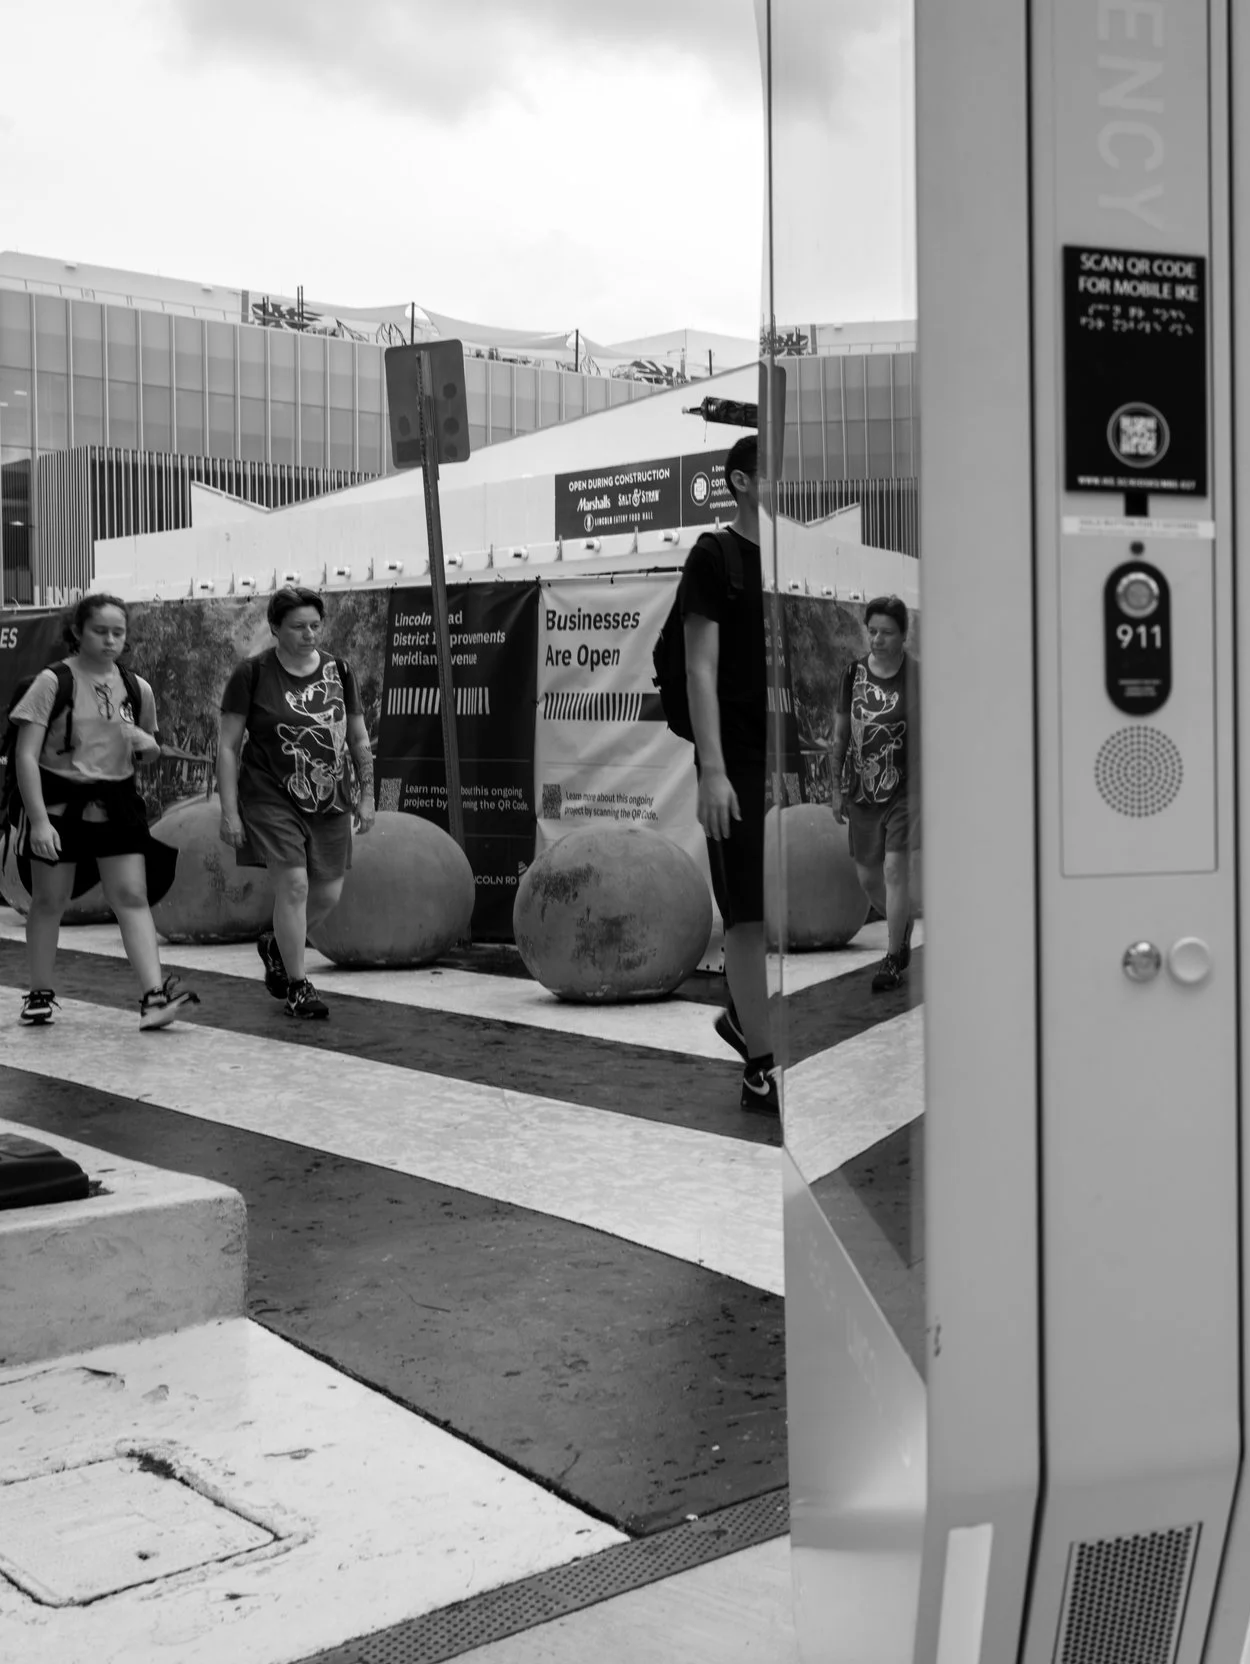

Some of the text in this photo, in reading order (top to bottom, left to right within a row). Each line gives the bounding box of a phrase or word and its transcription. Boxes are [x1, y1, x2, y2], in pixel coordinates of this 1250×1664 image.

[1080, 252, 1197, 279] SCAN QR CODE
[1078, 275, 1111, 295] FOR
[1113, 278, 1172, 300] MOBILE
[568, 468, 670, 492] OPEN DURING CONSTRUCTION
[577, 494, 611, 512] Marshalls
[395, 611, 432, 627] Lincoln
[546, 607, 641, 631] Businesses
[393, 629, 506, 648] District Iprovements
[1116, 623, 1162, 649] 911
[391, 651, 478, 667] Meridian venue
[545, 643, 620, 672] Are Open
[405, 783, 429, 795] Learn
[460, 785, 473, 796] bout
[491, 786, 523, 799] ongoing
[565, 791, 582, 801] Learn
[597, 792, 615, 803] about
[616, 792, 628, 804] this
[628, 794, 654, 808] ongoing
[403, 798, 434, 810] project
[436, 799, 448, 811] by
[480, 800, 495, 810] the
[498, 800, 511, 812] QR
[512, 800, 529, 811] Code.
[564, 805, 584, 817] project
[584, 805, 593, 818] by
[593, 807, 619, 821] scanning
[620, 808, 631, 818] the
[631, 809, 641, 820] QR
[505, 875, 517, 886] RD
